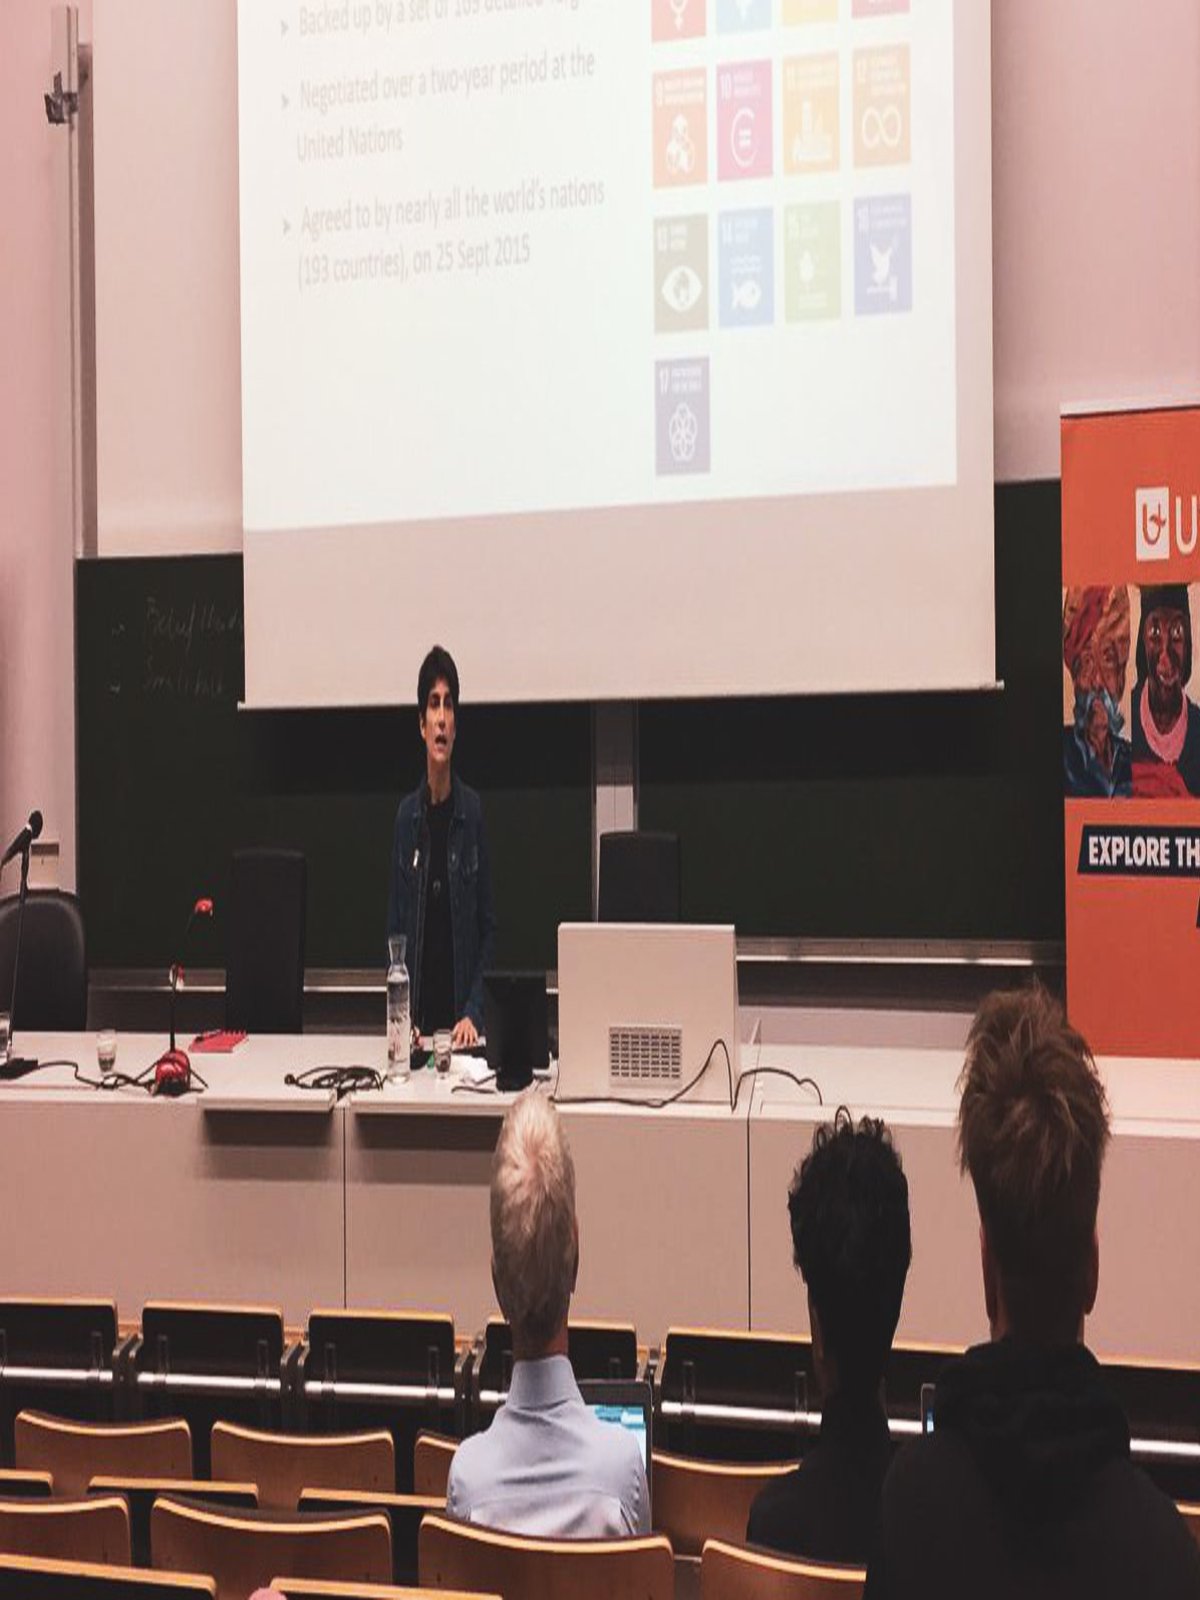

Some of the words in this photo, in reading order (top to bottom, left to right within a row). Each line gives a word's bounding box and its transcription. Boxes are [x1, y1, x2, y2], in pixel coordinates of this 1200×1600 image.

[300, 0, 349, 36] Backed
[353, 5, 371, 35] up
[375, 0, 392, 34] by
[396, 3, 405, 23] a
[409, 0, 431, 22] set
[301, 69, 378, 116] Negotiated
[383, 73, 415, 99] over
[418, 72, 427, 95] a
[430, 63, 496, 99] two-year
[500, 48, 547, 95] period
[552, 53, 567, 80] at
[570, 43, 595, 77] the
[297, 125, 344, 162] United
[349, 123, 403, 155] Nations
[302, 198, 352, 242] Agreed
[356, 202, 370, 229] to
[375, 196, 392, 232] by
[396, 189, 440, 229] nearly
[445, 184, 461, 220] all
[465, 186, 489, 218] the
[550, 177, 605, 208] nations
[298, 252, 329, 292] (193
[333, 244, 409, 284] countries),
[413, 249, 432, 273] on
[436, 240, 454, 272] 25
[457, 237, 490, 276] Sept
[495, 232, 530, 267] 2015
[1089, 836, 1170, 866] EXPLORE
